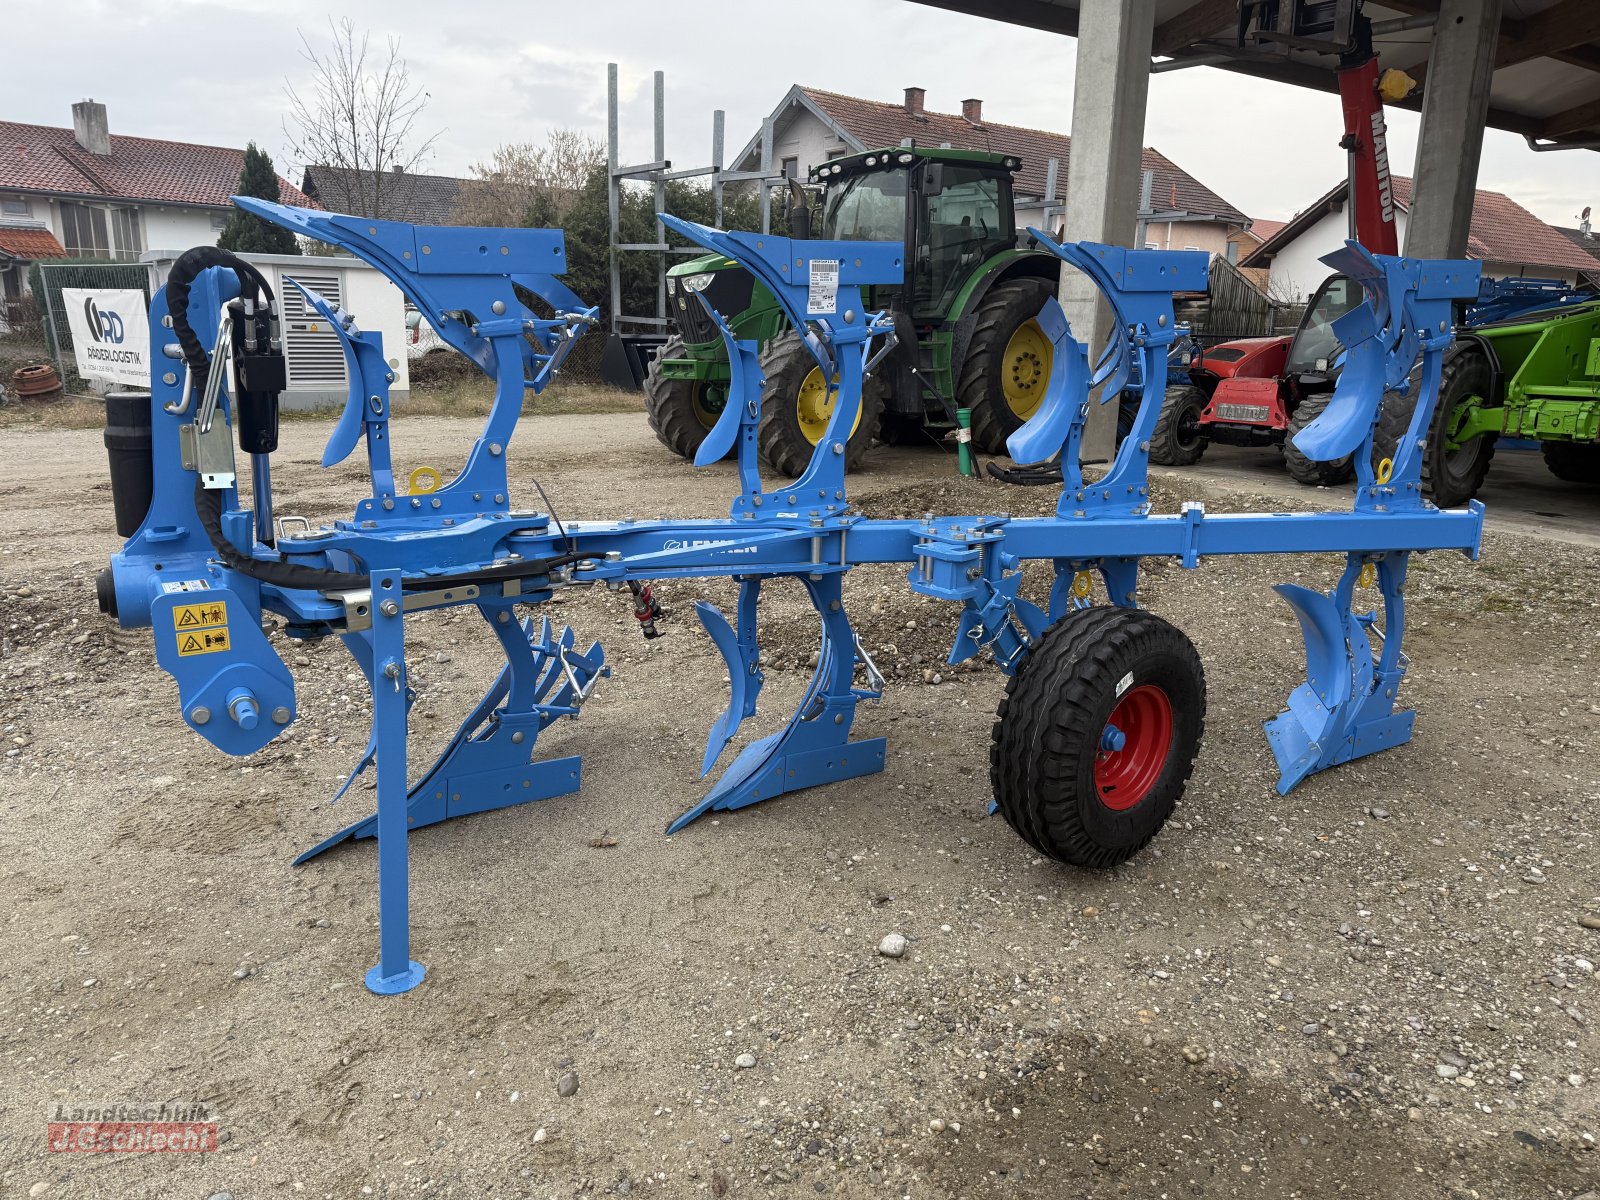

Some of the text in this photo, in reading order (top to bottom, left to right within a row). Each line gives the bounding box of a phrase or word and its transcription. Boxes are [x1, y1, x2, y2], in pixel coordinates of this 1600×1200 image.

[1371, 111, 1393, 223] MANITOU
[87, 346, 141, 364] RÄDERLOGISTIK
[1217, 404, 1268, 419] MANITOU
[682, 540, 757, 557] LEN
